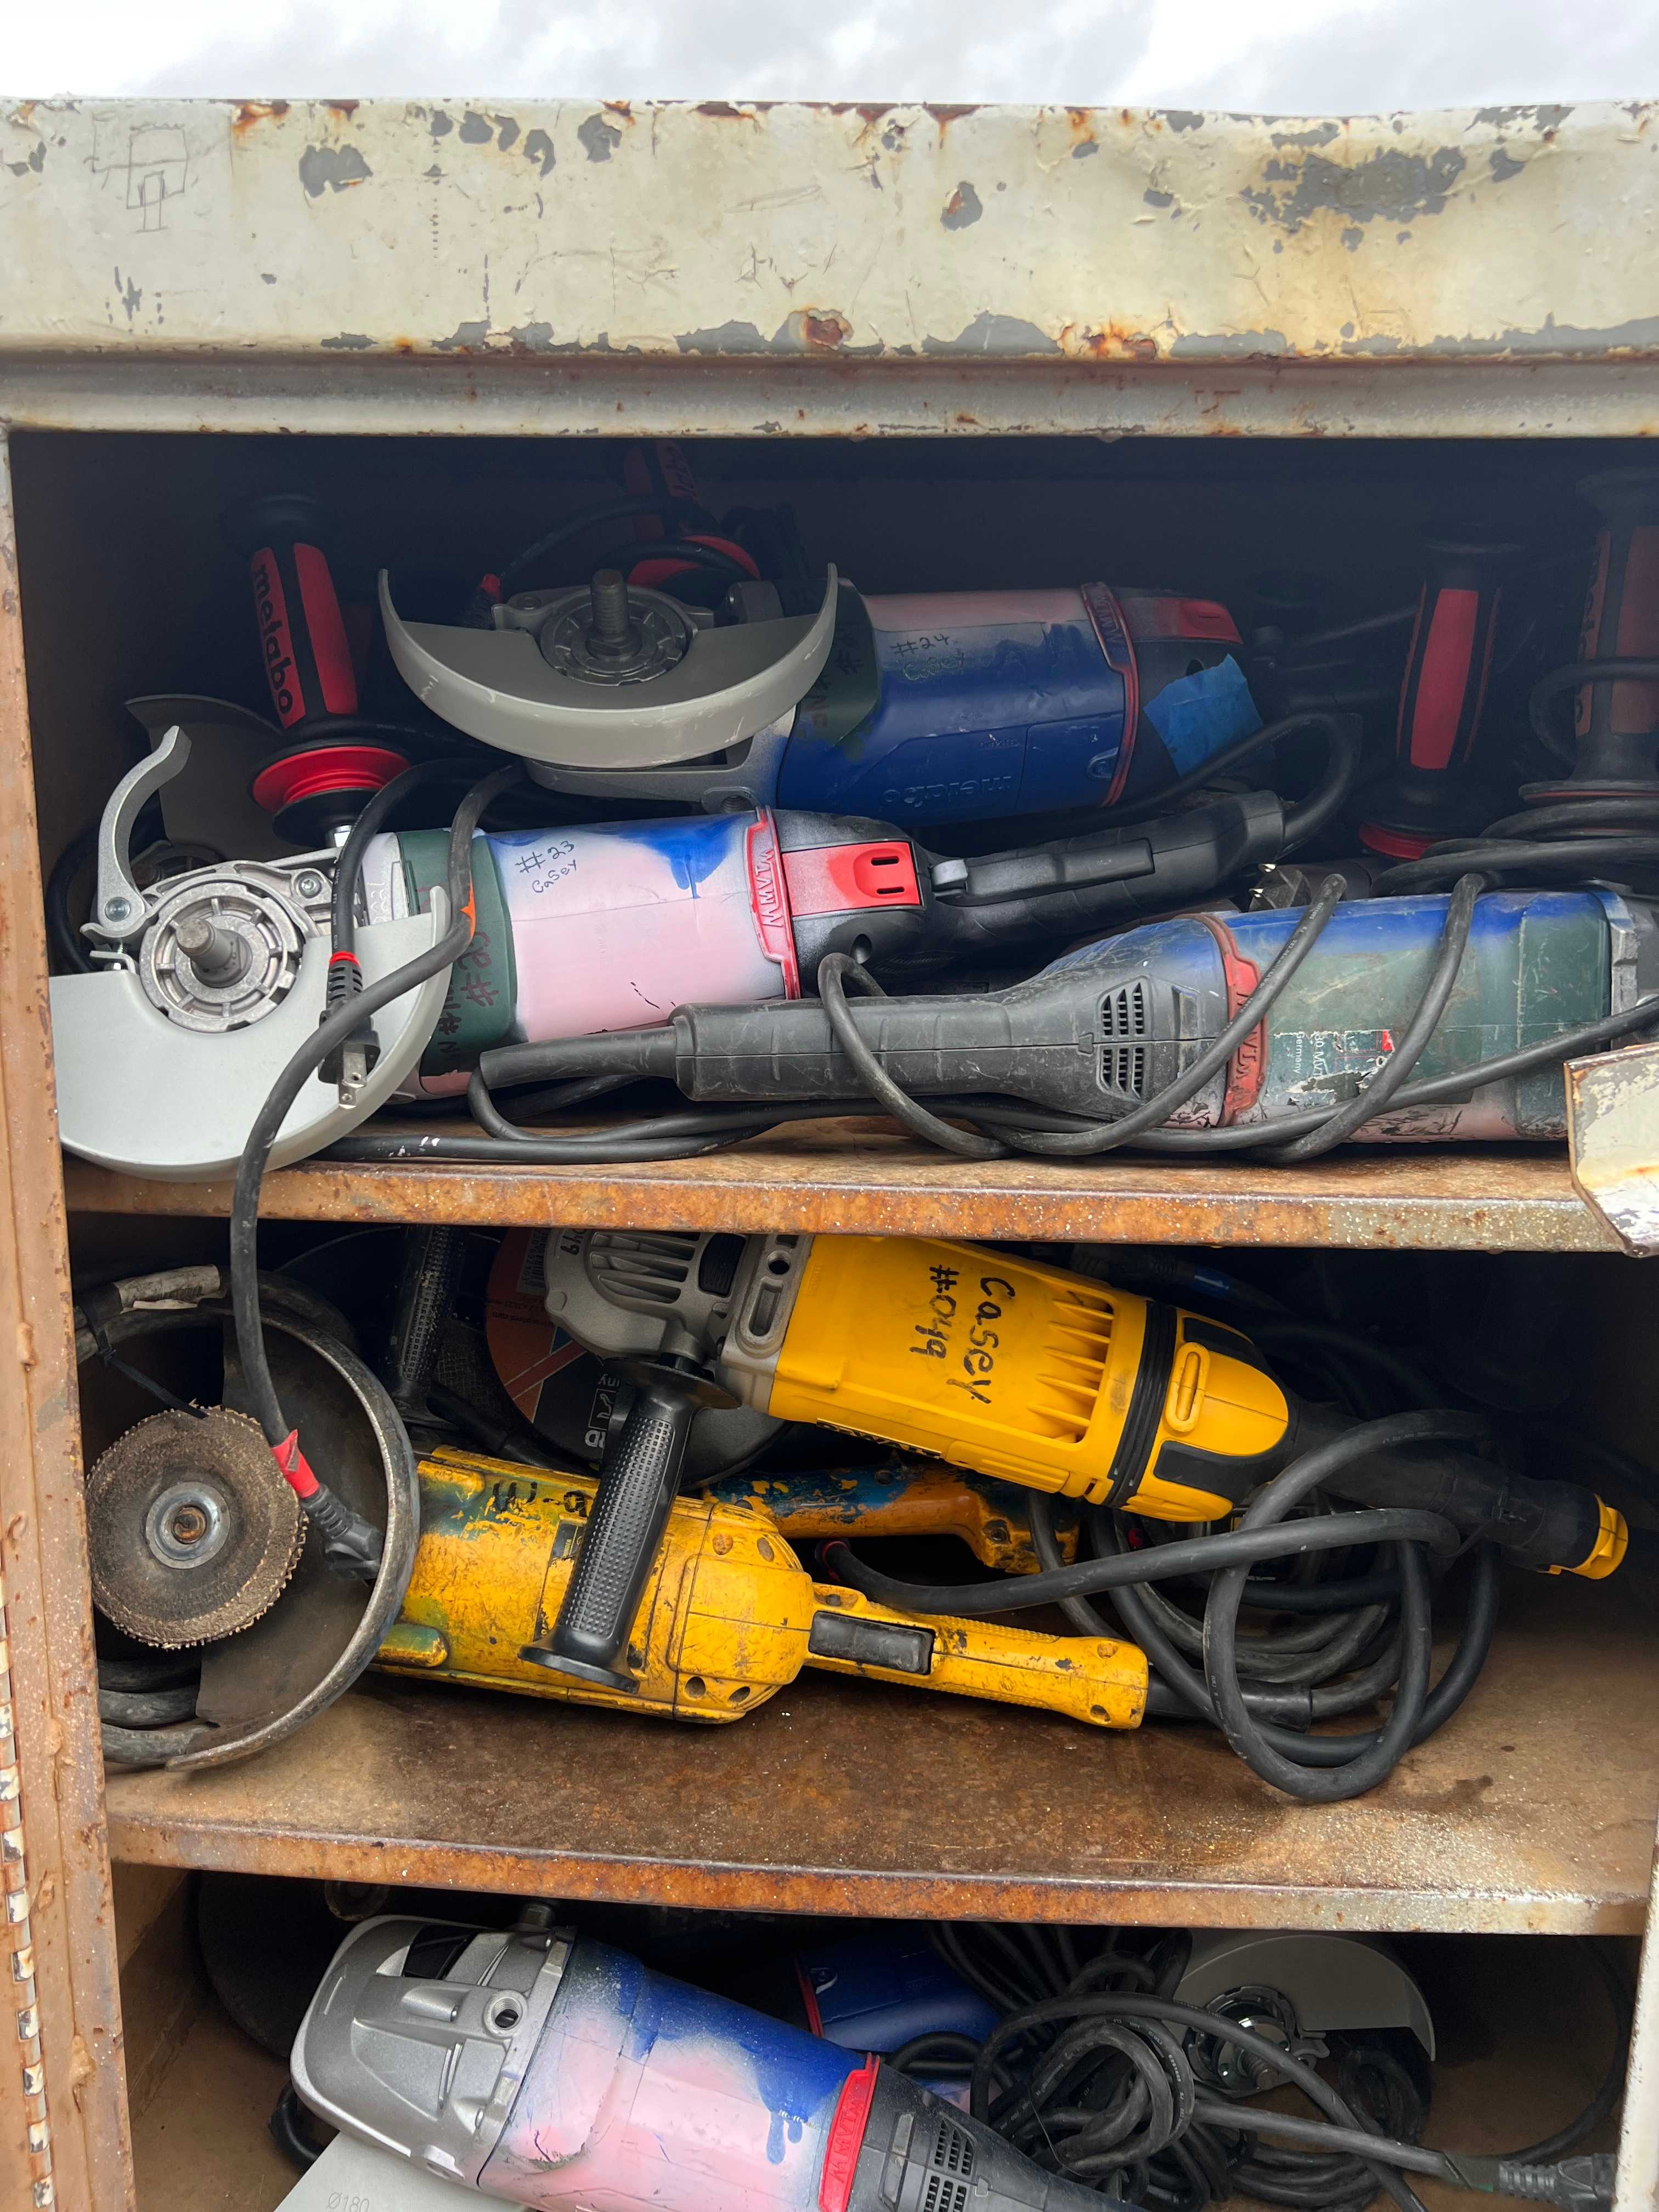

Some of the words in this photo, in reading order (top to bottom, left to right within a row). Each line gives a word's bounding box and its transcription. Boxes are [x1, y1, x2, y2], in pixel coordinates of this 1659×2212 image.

[253, 566, 294, 715] metabo
[889, 633, 950, 657] #24
[514, 840, 575, 873] #23
[909, 1264, 960, 1359] #049
[945, 1276, 1015, 1404] Casey
